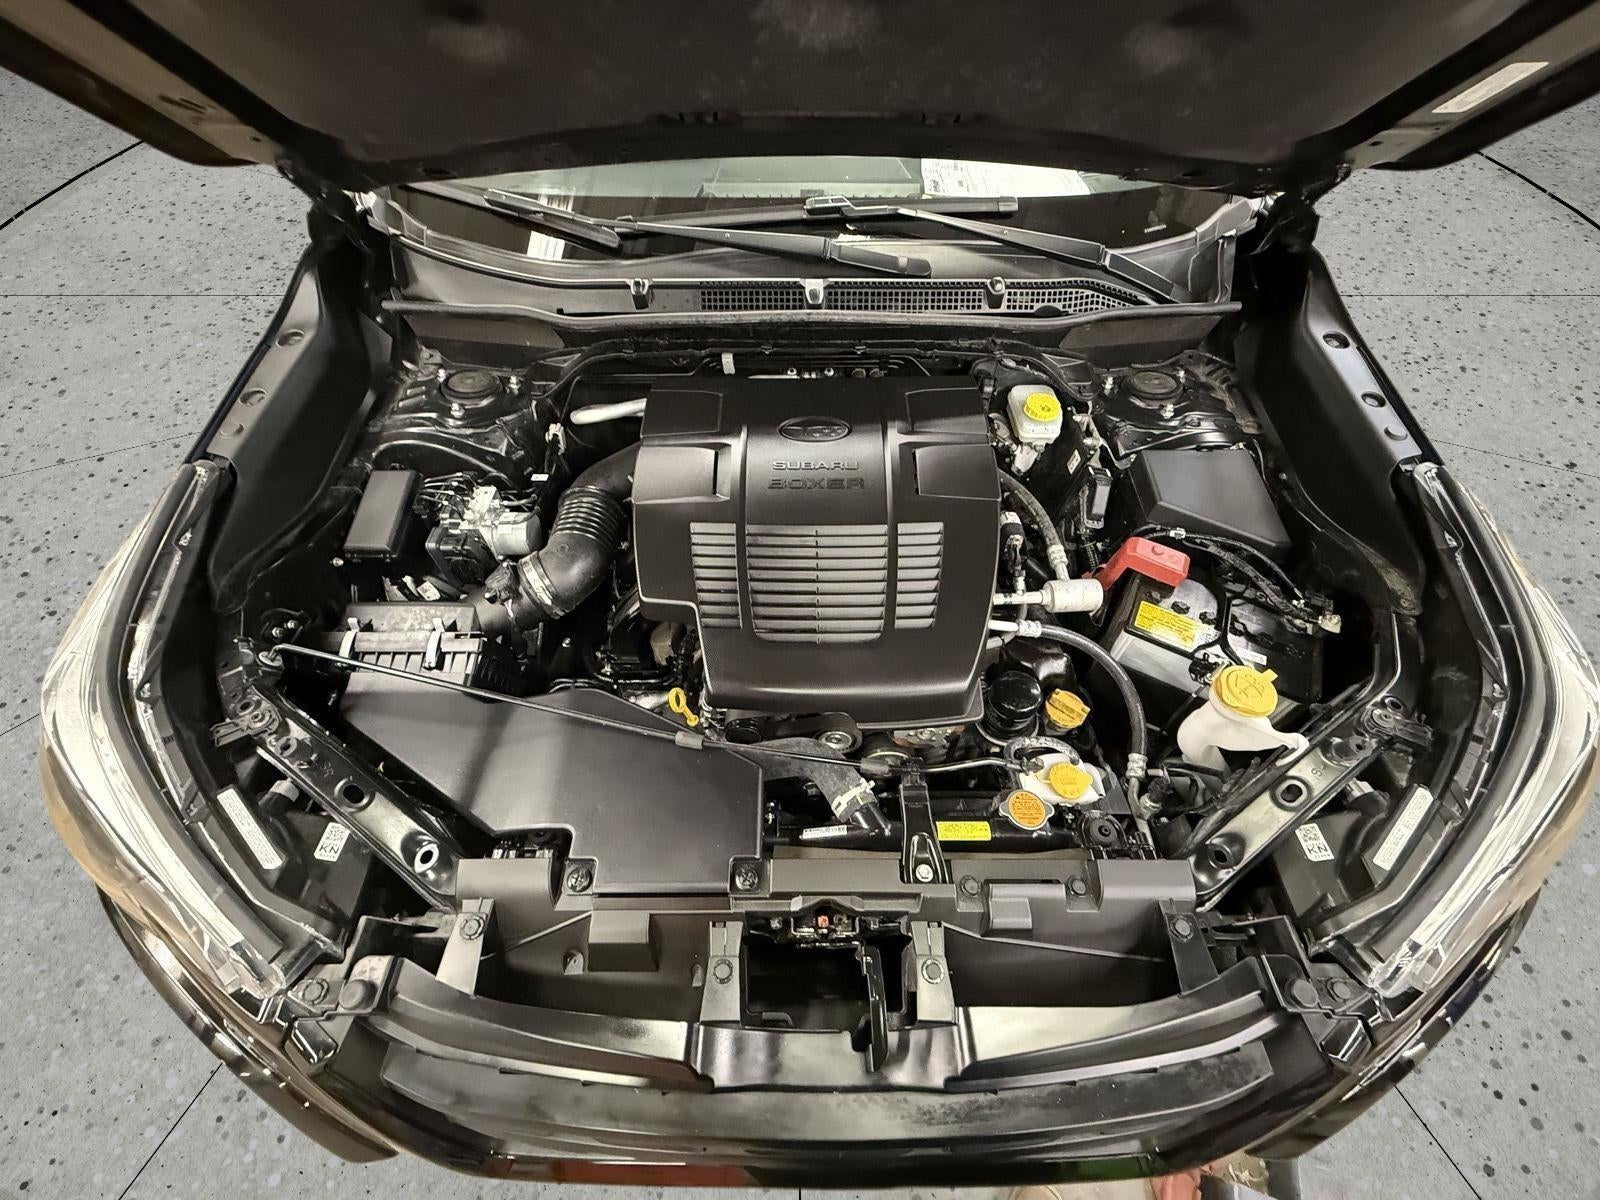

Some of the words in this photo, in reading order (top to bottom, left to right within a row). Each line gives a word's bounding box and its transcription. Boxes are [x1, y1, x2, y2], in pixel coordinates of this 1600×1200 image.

[772, 460, 859, 471] SUBARU
[767, 477, 865, 490] BOXER
[319, 844, 340, 854] KN
[1307, 844, 1328, 854] KN
